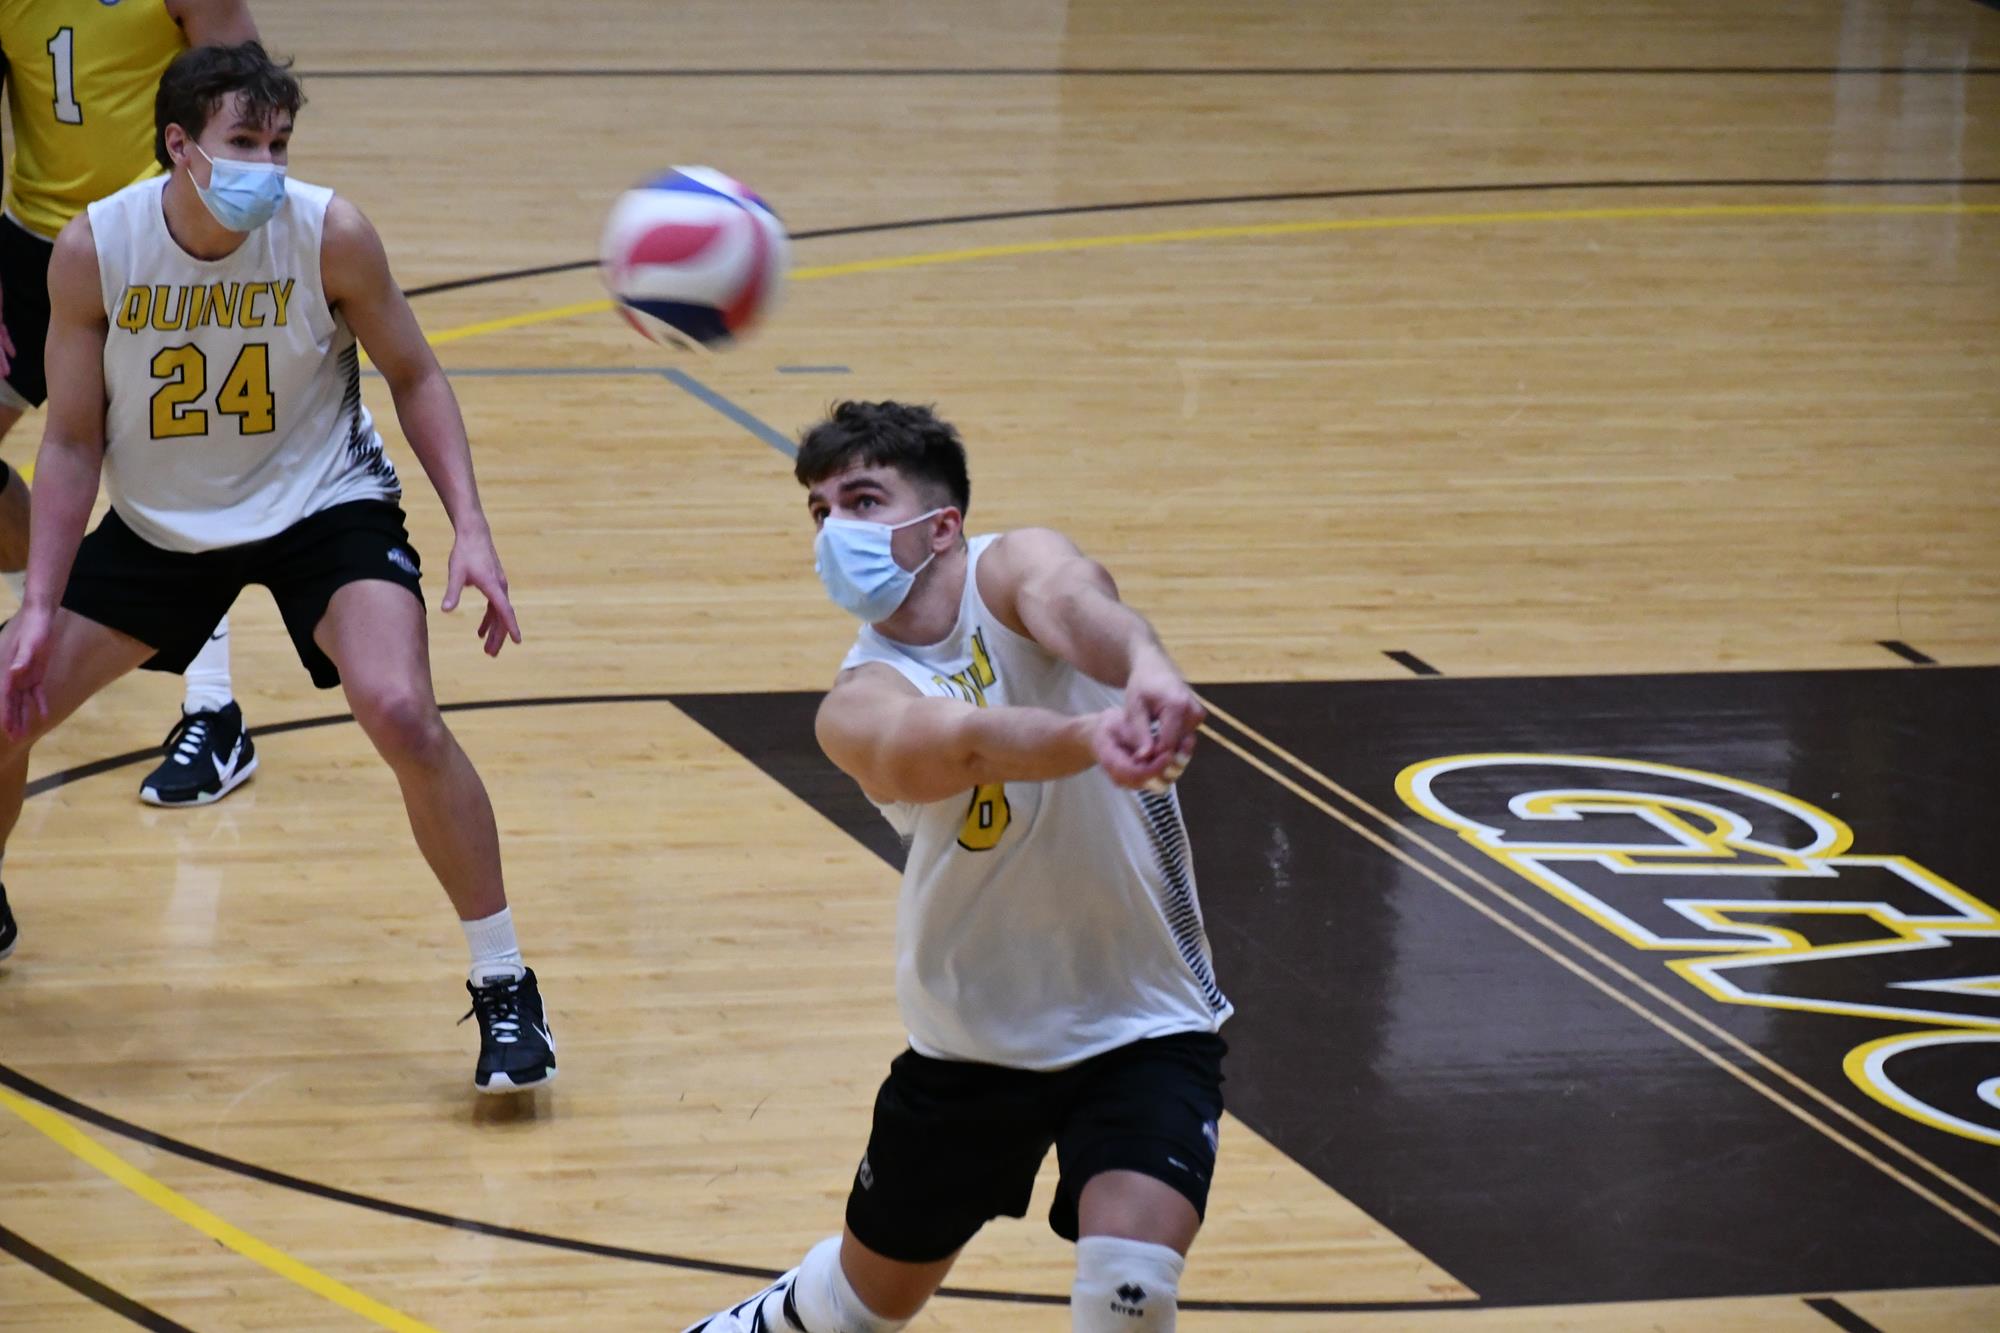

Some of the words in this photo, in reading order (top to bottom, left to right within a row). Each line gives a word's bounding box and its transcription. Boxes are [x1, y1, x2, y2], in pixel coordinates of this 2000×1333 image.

[46, 26, 83, 125] 1
[116, 278, 295, 334] QUINCY
[150, 342, 275, 439] 24
